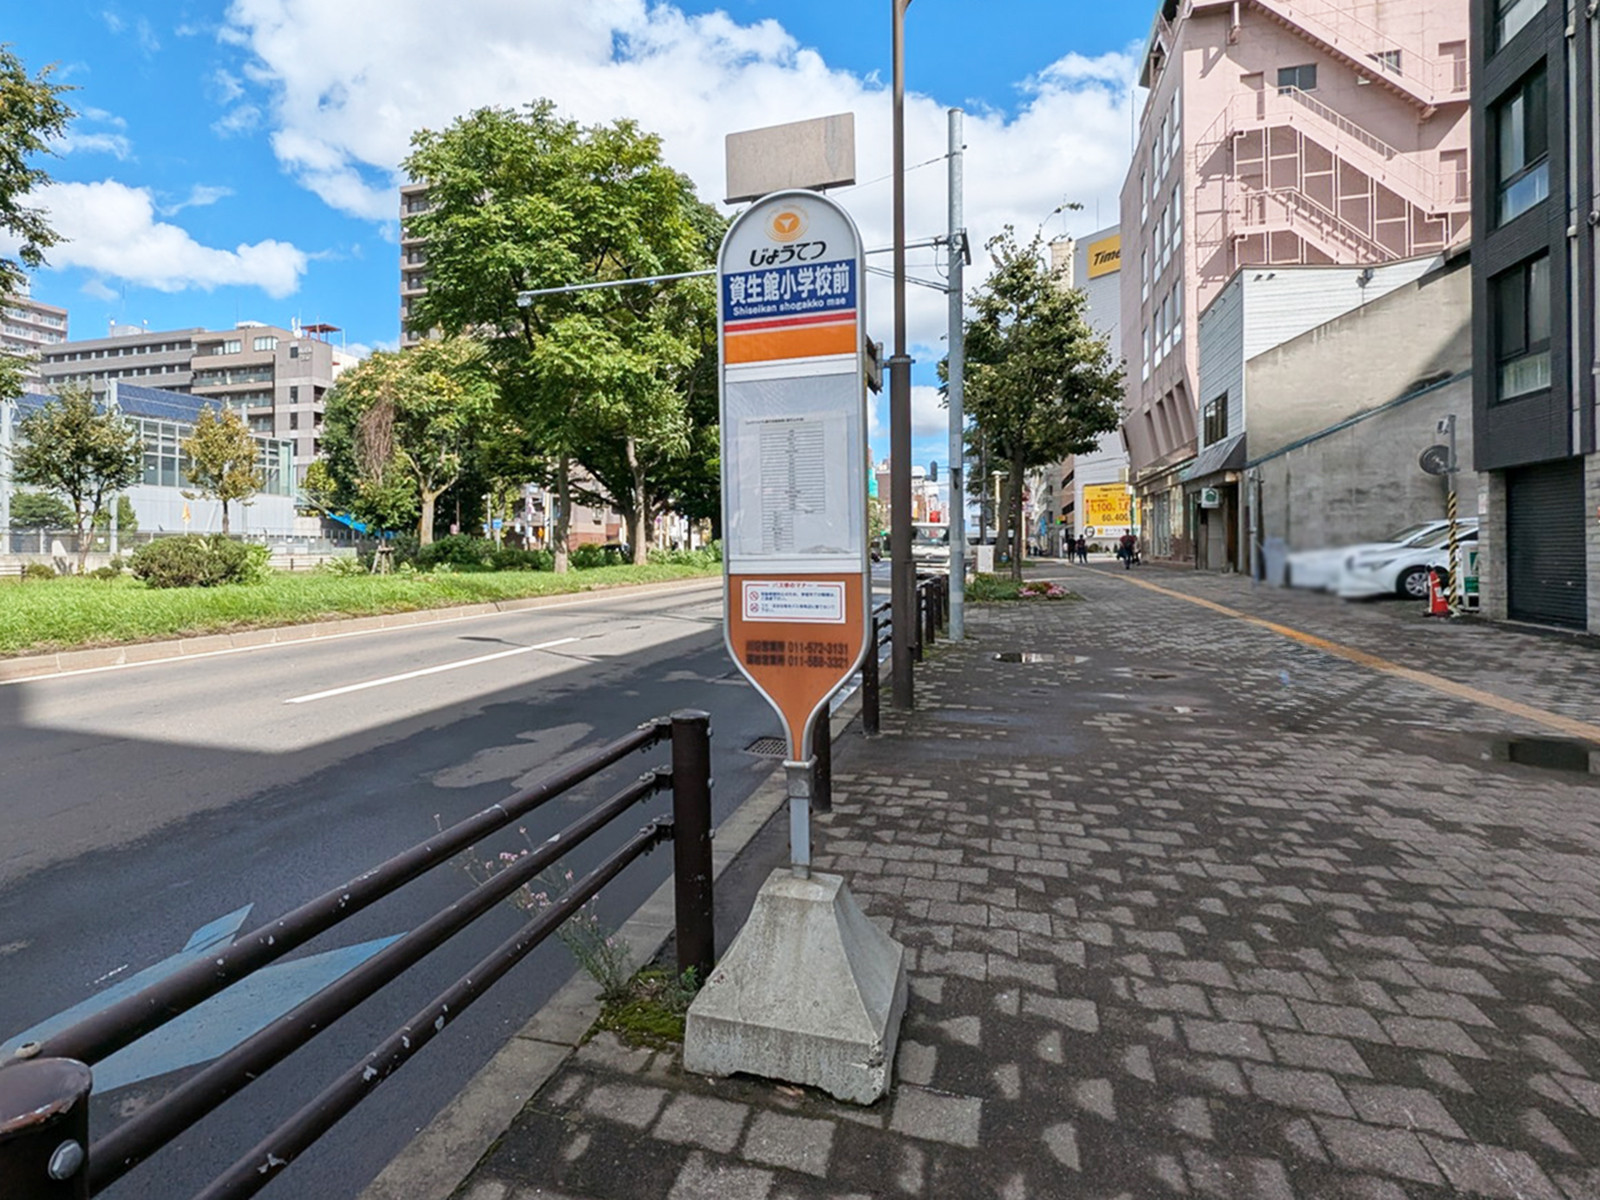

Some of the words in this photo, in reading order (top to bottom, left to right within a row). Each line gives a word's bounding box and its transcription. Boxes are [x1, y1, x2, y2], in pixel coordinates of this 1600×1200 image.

[749, 240, 827, 267] じょうてつ
[729, 263, 849, 306] 資生館小学校前
[733, 304, 778, 317] Shiseikan
[779, 299, 825, 311] shogakko
[826, 297, 846, 306] mae
[787, 641, 848, 655] 011-572-3131
